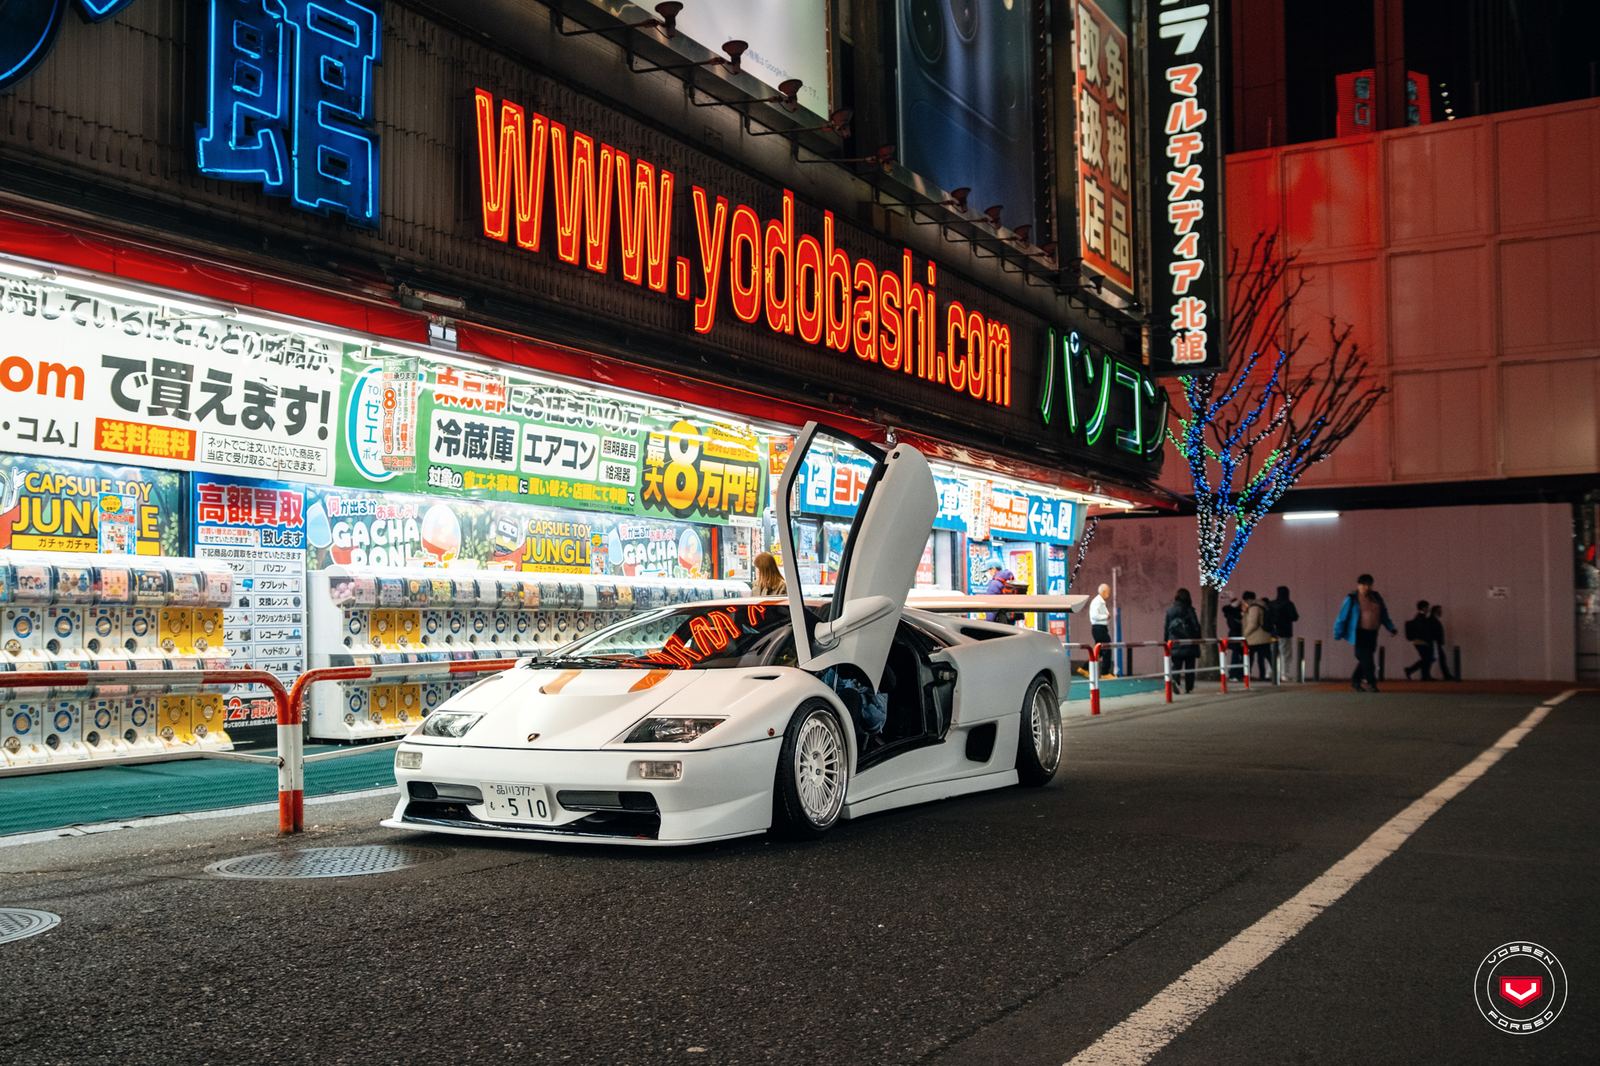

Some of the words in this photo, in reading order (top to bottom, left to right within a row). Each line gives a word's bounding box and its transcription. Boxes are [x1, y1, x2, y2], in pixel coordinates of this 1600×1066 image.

[1159, 0, 1210, 55] ラ
[1078, 3, 1105, 259] 取扱店
[1105, 35, 1130, 273] 免税品
[1165, 62, 1208, 364] マルチメディア北館
[475, 87, 1011, 408] www.yodobashi.com
[0, 277, 335, 374] 売しているほとんどの商品が、
[0, 356, 85, 401] om
[101, 354, 330, 440] で買えます!
[1041, 327, 1167, 460] パソコン
[101, 421, 190, 458] 送料無料
[208, 436, 321, 461] ネットでご注文いただいた商品を
[434, 417, 515, 463] 冷蔵庫
[523, 432, 596, 471] エアコン
[207, 449, 316, 472] 当店で受け取ることもできます。
[25, 472, 111, 497] CAPSULE
[115, 480, 153, 502] TOY
[12, 497, 160, 538] JUNE
[198, 484, 303, 527] 高額買取
[38, 538, 91, 548] ガチャガチャ
[263, 530, 303, 546] 致します
[332, 518, 419, 548] GACHA
[528, 519, 570, 536] CAPSULE
[572, 523, 591, 538] TOY
[624, 540, 677, 564] GACHA
[263, 564, 286, 573] パソコン
[260, 580, 287, 590] タブレット
[259, 597, 288, 607] 交換レンズ
[257, 613, 291, 623] アクションカメラ
[260, 630, 288, 639] レコーダー
[262, 647, 290, 656] ヘッドホン
